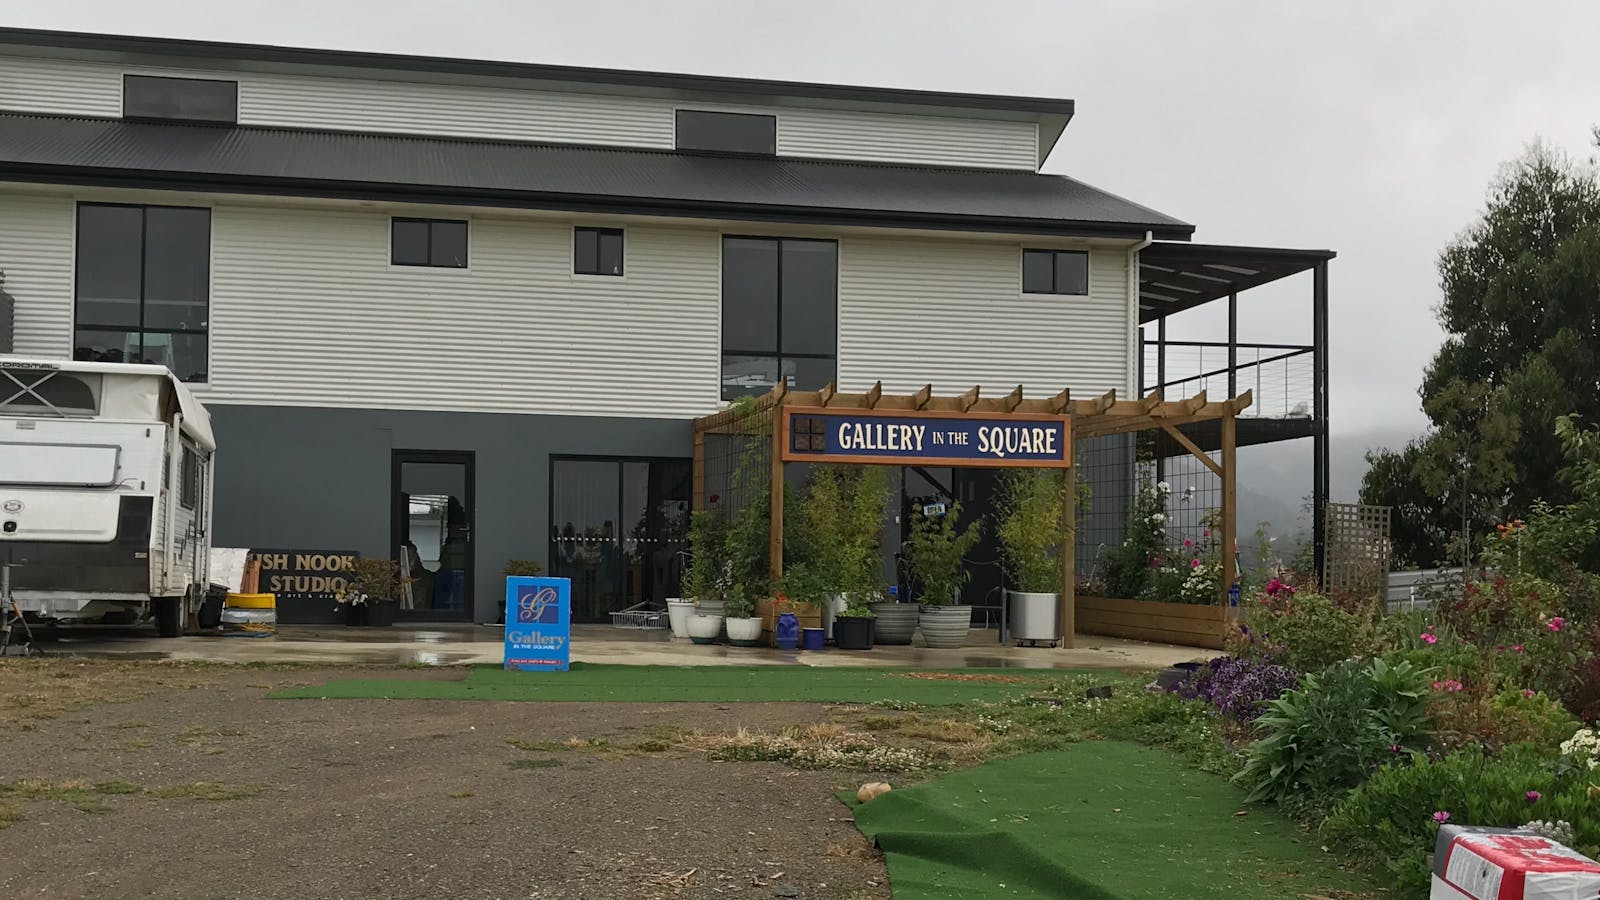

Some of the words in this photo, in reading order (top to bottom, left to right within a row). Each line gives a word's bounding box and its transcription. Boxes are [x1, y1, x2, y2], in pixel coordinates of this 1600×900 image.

[838, 422, 926, 451] GALLERY
[932, 431, 945, 444] IN
[947, 432, 969, 445] THE
[977, 426, 1057, 457] SQUARE
[295, 554, 356, 572] NOOK
[270, 575, 348, 593] STUDIO
[509, 631, 566, 650] Gallery
